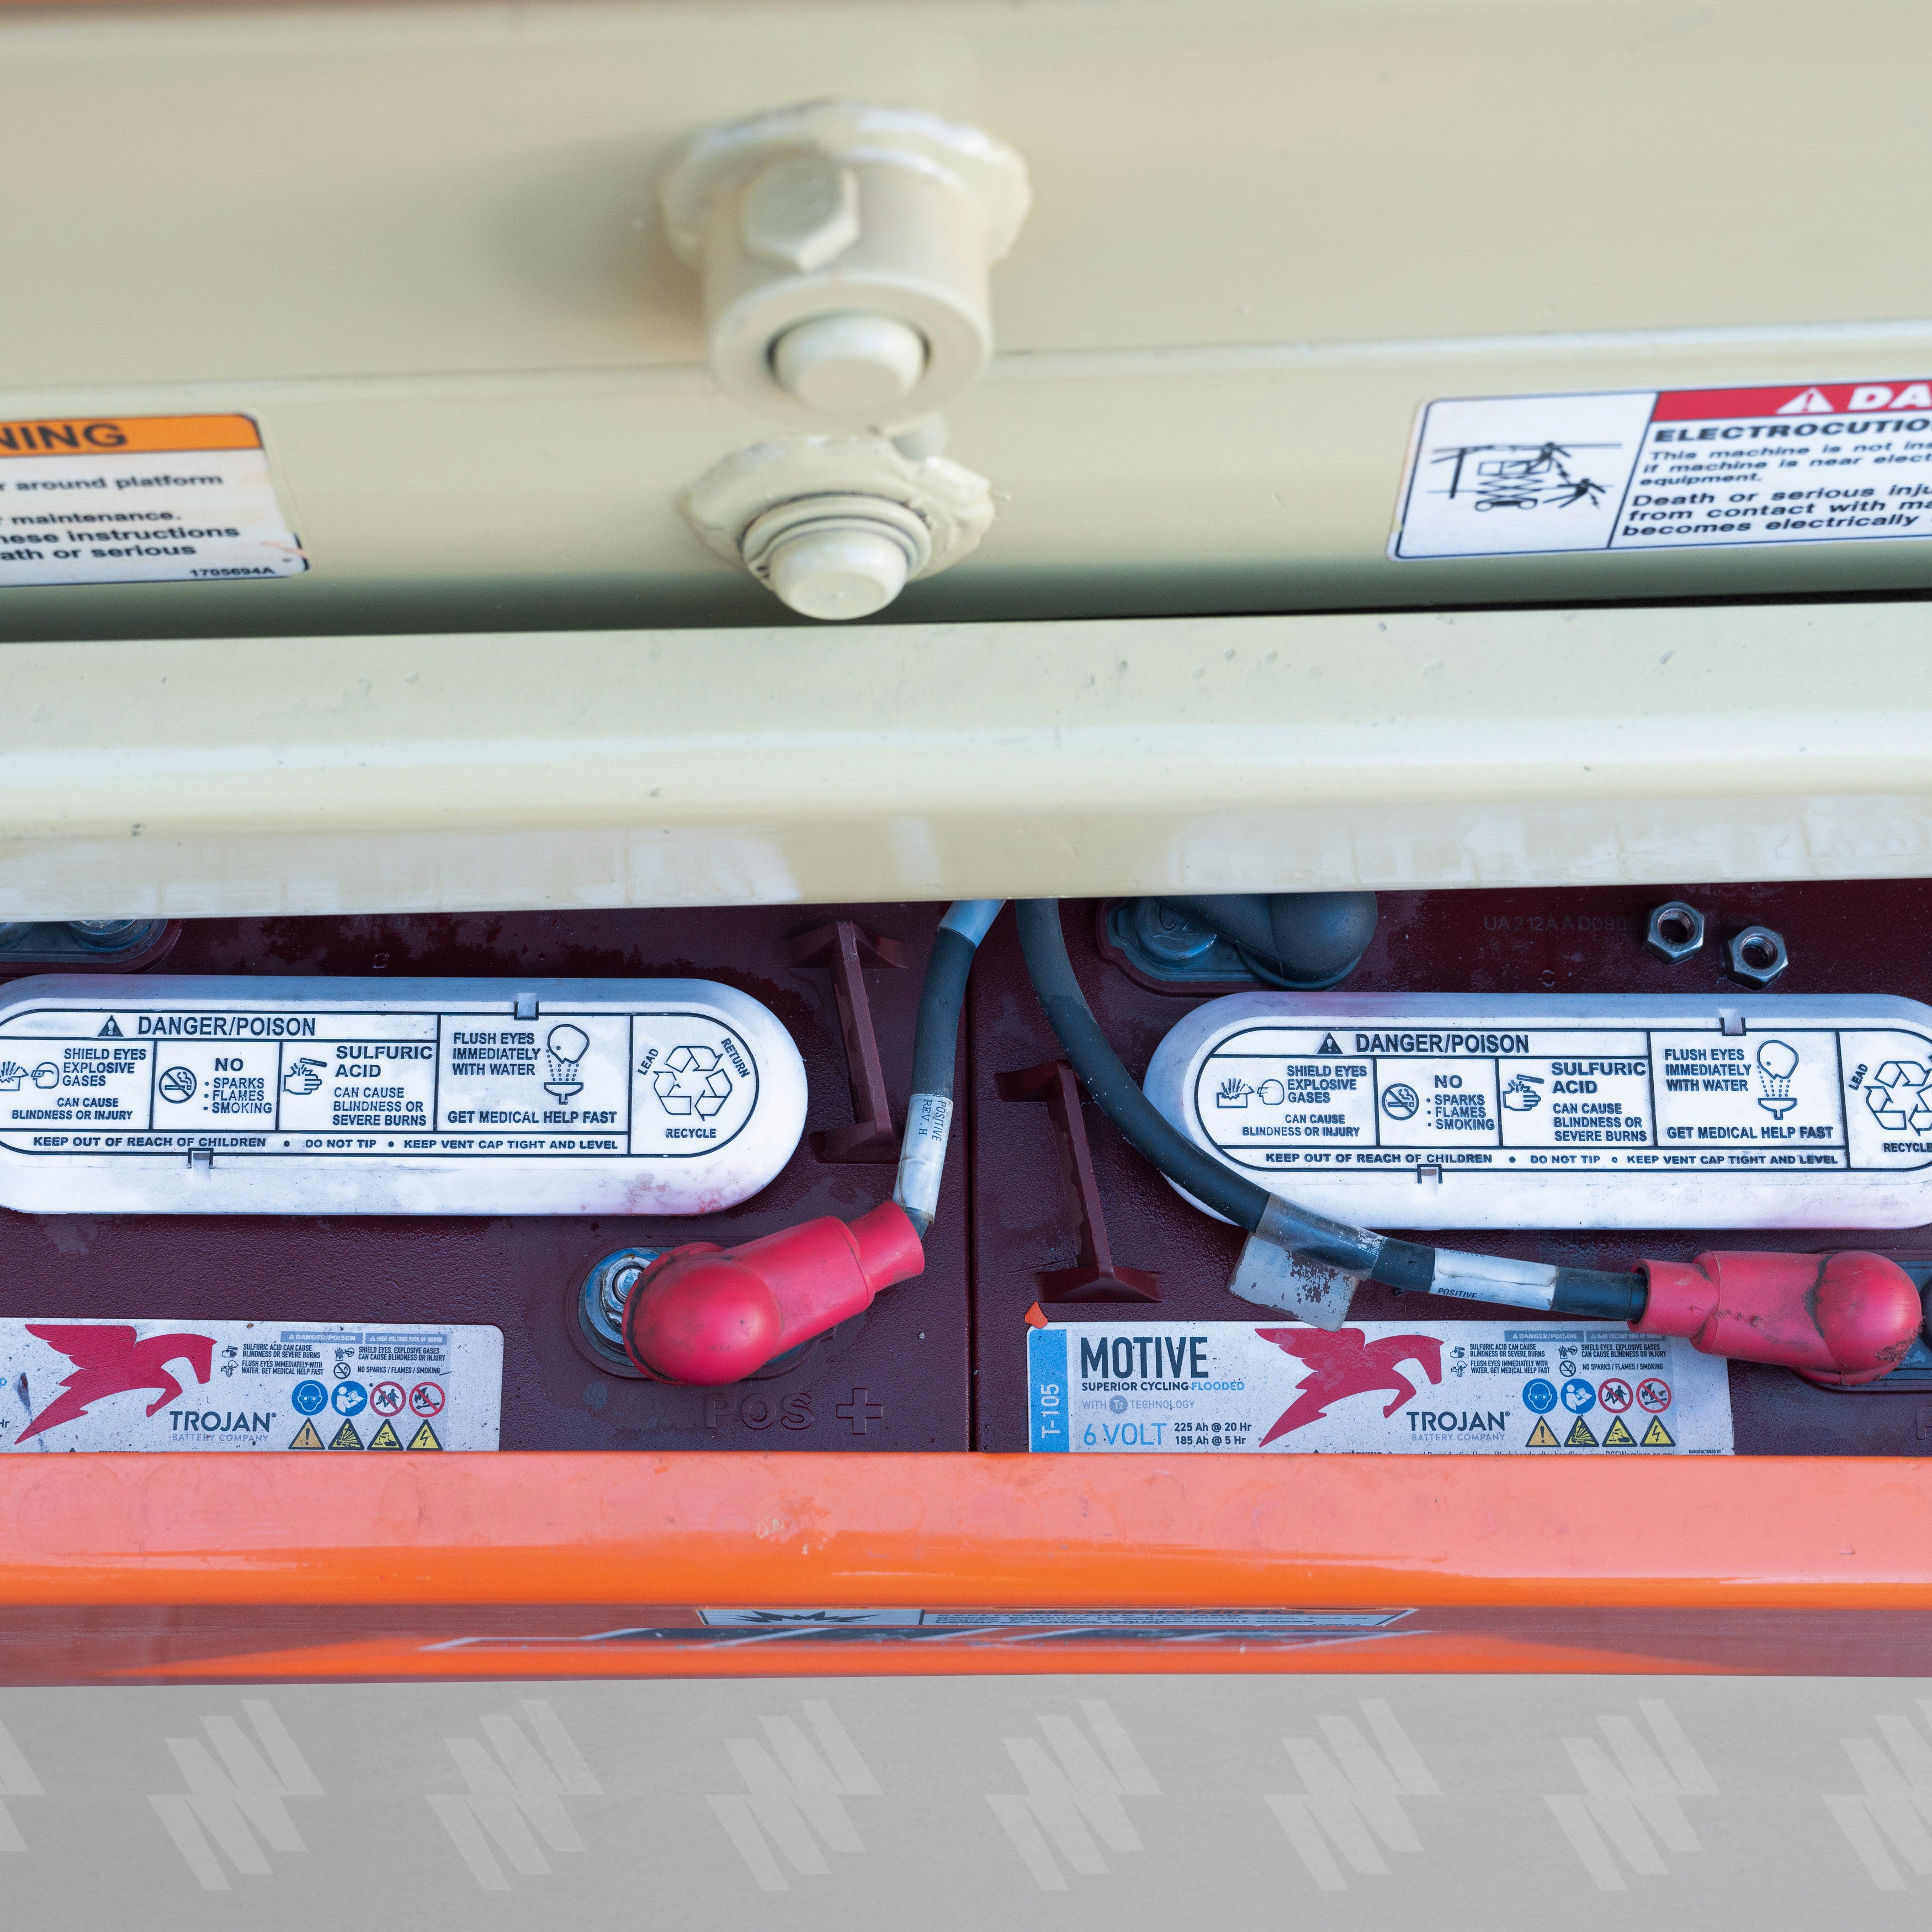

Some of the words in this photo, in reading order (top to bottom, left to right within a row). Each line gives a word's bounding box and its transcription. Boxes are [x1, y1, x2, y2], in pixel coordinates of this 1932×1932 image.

[1650, 450, 1696, 460] This
[1710, 447, 1809, 459] machine
[1822, 445, 1840, 454] is
[1854, 443, 1893, 453] not
[1669, 460, 1767, 473] machine
[1779, 459, 1797, 468] is
[1809, 456, 1861, 467] near
[16, 476, 107, 490] around
[116, 474, 222, 490] platform
[1639, 473, 1762, 486] equipment.
[1632, 493, 1715, 506] Death
[1729, 492, 1758, 503] or
[1771, 487, 1875, 501] serious
[12, 510, 181, 524] maintenance.
[1629, 509, 1692, 521] from
[1707, 503, 1814, 518] contact
[1829, 500, 1886, 512] with
[1622, 522, 1751, 537] becomes
[1766, 514, 1920, 530] electrically
[68, 526, 241, 543] instructions
[54, 548, 80, 559] or
[92, 543, 197, 557] serious
[138, 1016, 316, 1036] DANGER/POISON
[454, 1032, 497, 1045] FLUSH
[500, 1032, 534, 1045] EYES
[1356, 1034, 1529, 1053] DANGER/POISON
[63, 1048, 110, 1060] SHIELD
[113, 1048, 147, 1060] EYES
[336, 1045, 433, 1059] SULFURIC
[453, 1048, 540, 1060] IMMEDIATELY
[721, 1038, 750, 1078] RETURN
[1665, 1049, 1708, 1061] FLUSH
[1711, 1049, 1744, 1061] EYES
[63, 1061, 135, 1074] EXPLOSIVE
[215, 1058, 243, 1071] NO
[637, 1048, 658, 1075] LEAD
[335, 1064, 381, 1077] ACID
[453, 1063, 486, 1075] WITH
[490, 1063, 535, 1075] WATER
[1552, 1062, 1646, 1076] SULFURIC
[1665, 1064, 1751, 1076] IMMEDIATELY
[62, 1075, 106, 1087] GASES
[212, 1078, 264, 1089] SPARKS
[1434, 1075, 1462, 1089] NO
[1552, 1080, 1597, 1094] ACID
[1667, 1079, 1700, 1091] WITH
[1703, 1079, 1748, 1091] WATER
[212, 1090, 264, 1101] FLAMES
[335, 1087, 358, 1098] CAN
[363, 1087, 404, 1098] CAUSE
[57, 1097, 79, 1108] CAN
[83, 1097, 119, 1108] CAUSE
[333, 1101, 402, 1112] BLINDNESS
[406, 1101, 423, 1112] OR
[1434, 1094, 1484, 1106] SPARKS
[211, 1102, 272, 1113] SMOKING
[1436, 1107, 1486, 1118] FLAMES
[12, 1110, 72, 1120] BLINDNESS
[76, 1110, 92, 1120] OR
[94, 1110, 132, 1120] INJURY
[332, 1114, 380, 1126] SEVERE
[384, 1114, 426, 1126] BURNS
[448, 1110, 475, 1124] GET
[479, 1110, 539, 1124] MEDICAL
[544, 1110, 578, 1124] HELP
[583, 1110, 617, 1124] FAST
[932, 1101, 946, 1142] POSITIVE
[1436, 1118, 1494, 1130] SMOKING
[666, 1128, 716, 1138] RECYCLE
[34, 1136, 68, 1148] KEEP
[72, 1136, 101, 1148] OUT
[105, 1136, 124, 1148] OF
[127, 1136, 173, 1148] REACH
[177, 1136, 194, 1148] OF
[198, 1136, 266, 1148] CHILDREN
[305, 1136, 323, 1148] DO
[327, 1136, 353, 1148] NOT
[357, 1136, 377, 1148] TIP
[404, 1140, 437, 1150] KEEP
[442, 1140, 474, 1150] VENT
[478, 1140, 503, 1150] CAP
[507, 1140, 545, 1150] TIGHT
[549, 1140, 575, 1150] AND
[579, 1140, 618, 1150] LEVEL
[1438, 1288, 1477, 1298] POSITIVE
[1081, 1337, 1208, 1378] MOTIVE
[1082, 1382, 1137, 1391] SUPERIOR
[1140, 1382, 1188, 1391] CYCLING
[1191, 1382, 1245, 1391] FLOODED
[1041, 1383, 1060, 1439] T-105
[1082, 1400, 1106, 1409] WITH
[1130, 1400, 1195, 1409] TECHNOLOGY
[705, 1393, 814, 1430] POS
[1175, 1423, 1192, 1431] 225
[1196, 1423, 1208, 1431] Ah
[1212, 1423, 1221, 1432] @
[1225, 1423, 1236, 1431] 20
[1240, 1423, 1252, 1431] Hr
[1084, 1424, 1096, 1446] 6
[1103, 1424, 1167, 1446] VOLT
[1176, 1436, 1192, 1445] 185
[1196, 1436, 1209, 1445] Ah
[1212, 1436, 1222, 1446] @
[1225, 1436, 1231, 1445] 5
[1234, 1436, 1246, 1445] Hr
